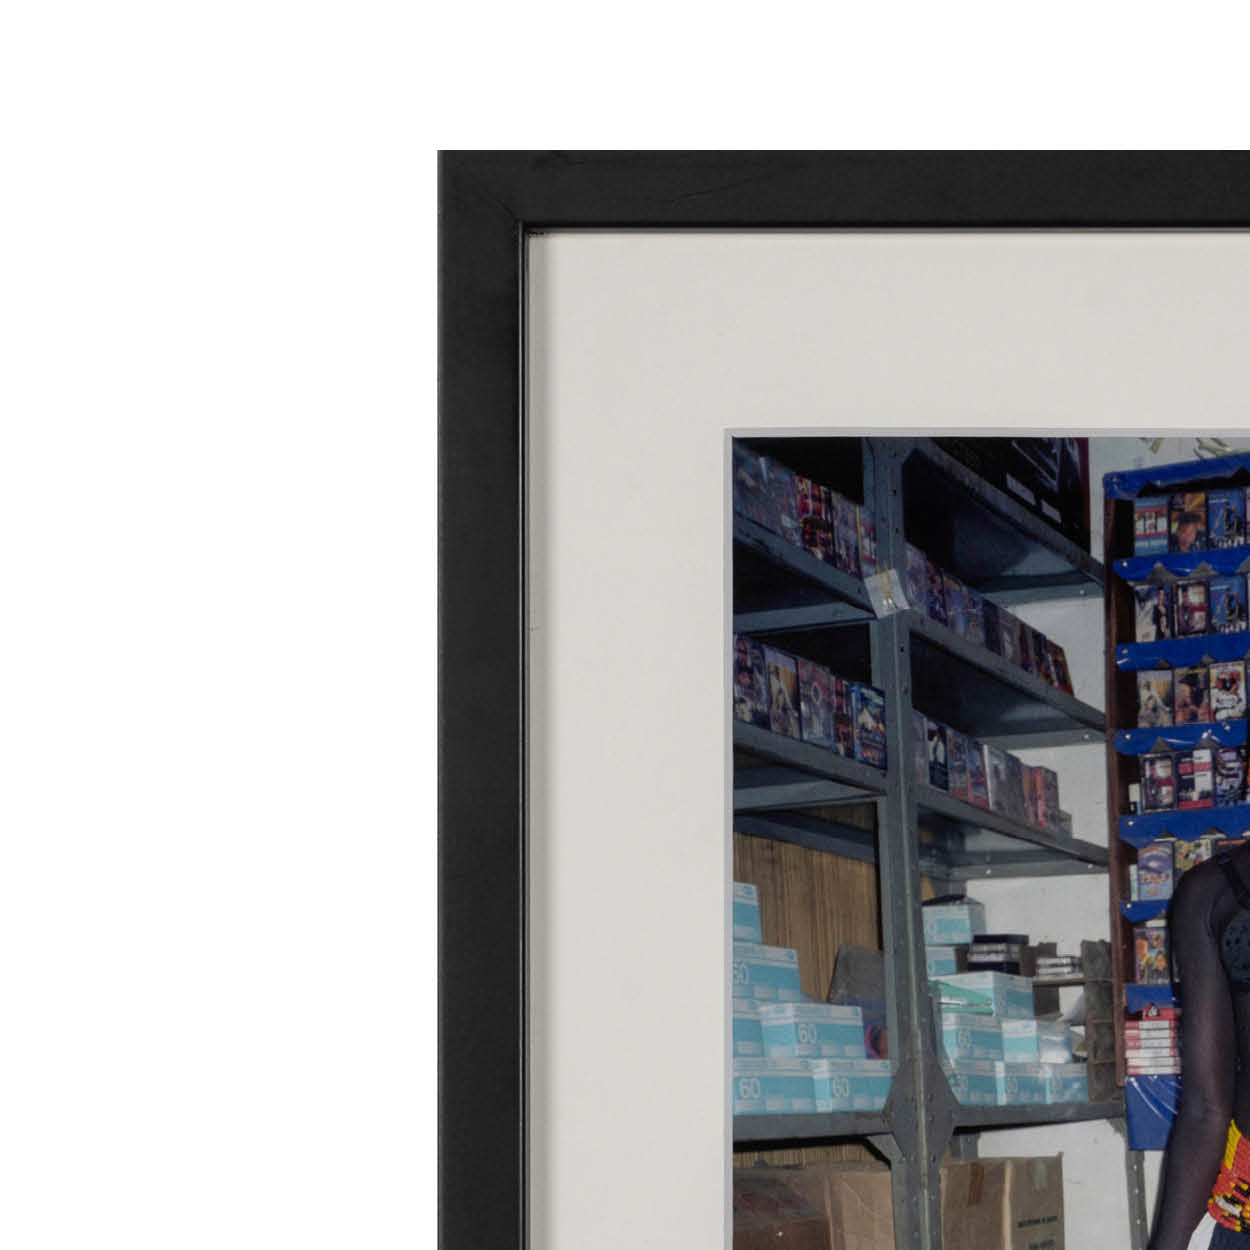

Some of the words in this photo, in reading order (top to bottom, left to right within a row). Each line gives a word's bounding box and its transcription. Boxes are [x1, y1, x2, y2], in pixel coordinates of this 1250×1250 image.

[798, 1023, 817, 1044] 60
[738, 1077, 761, 1099] 60
[831, 1076, 850, 1097] 60
